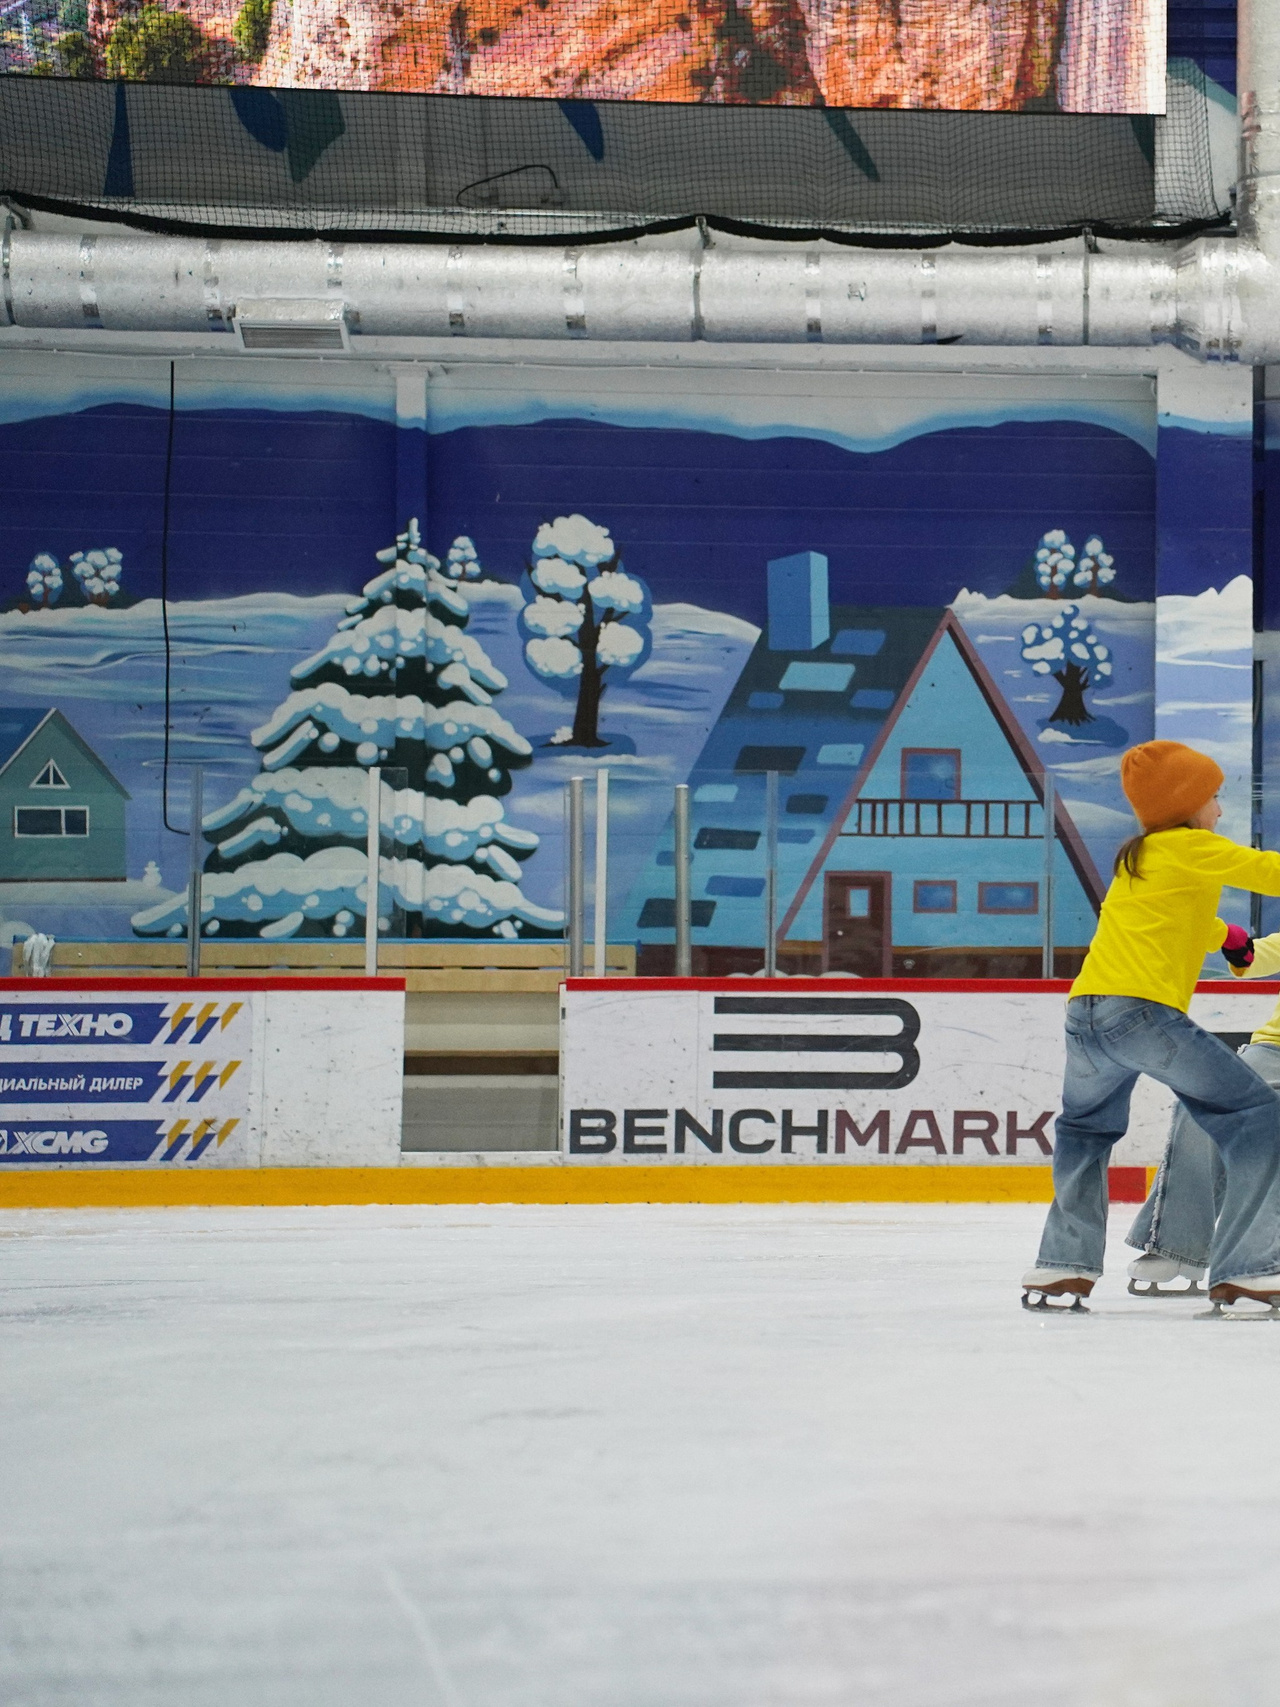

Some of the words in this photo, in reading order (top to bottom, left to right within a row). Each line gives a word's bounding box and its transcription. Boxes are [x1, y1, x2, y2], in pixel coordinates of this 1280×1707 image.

[18, 1012, 133, 1037] ТЕХНО
[0, 1074, 86, 1092] ИАЛЬНЫЙ
[89, 1077, 143, 1092] ДИЛЕР
[7, 1130, 109, 1154] XCMG
[569, 1108, 1056, 1156] BENCHMARK
